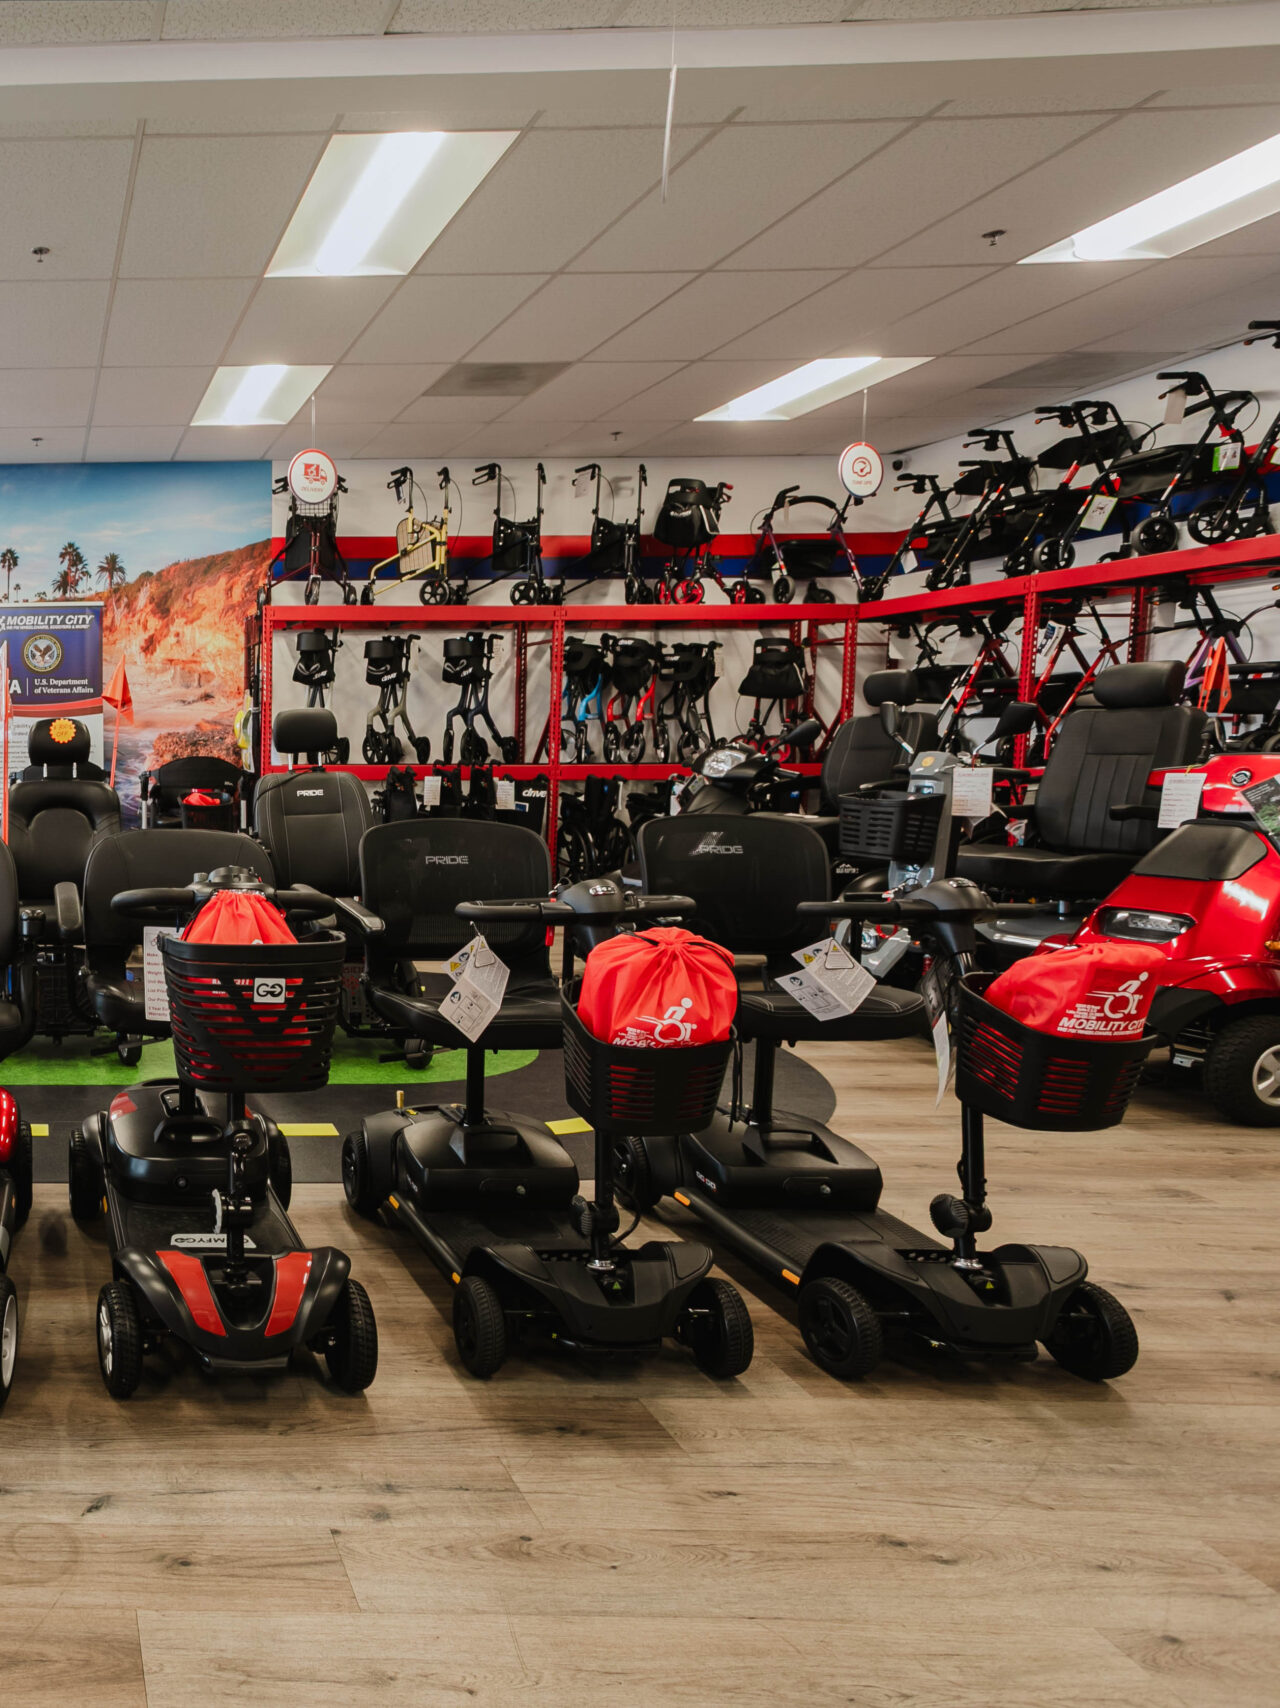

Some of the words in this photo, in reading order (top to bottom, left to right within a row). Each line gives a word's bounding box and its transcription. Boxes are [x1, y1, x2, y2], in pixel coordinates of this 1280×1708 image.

[6, 615, 64, 625] MOBILITY
[65, 615, 93, 625] CITY
[8, 679, 22, 694] A
[49, 678, 89, 687] Department
[34, 686, 42, 694] of
[42, 686, 71, 694] Veterans
[72, 686, 94, 694] Affairs
[296, 789, 324, 797] PRIDE
[522, 788, 547, 798] drive
[700, 845, 744, 854] PRIDE
[425, 855, 469, 865] PRIDE
[1059, 1017, 1128, 1031] MOBILITY
